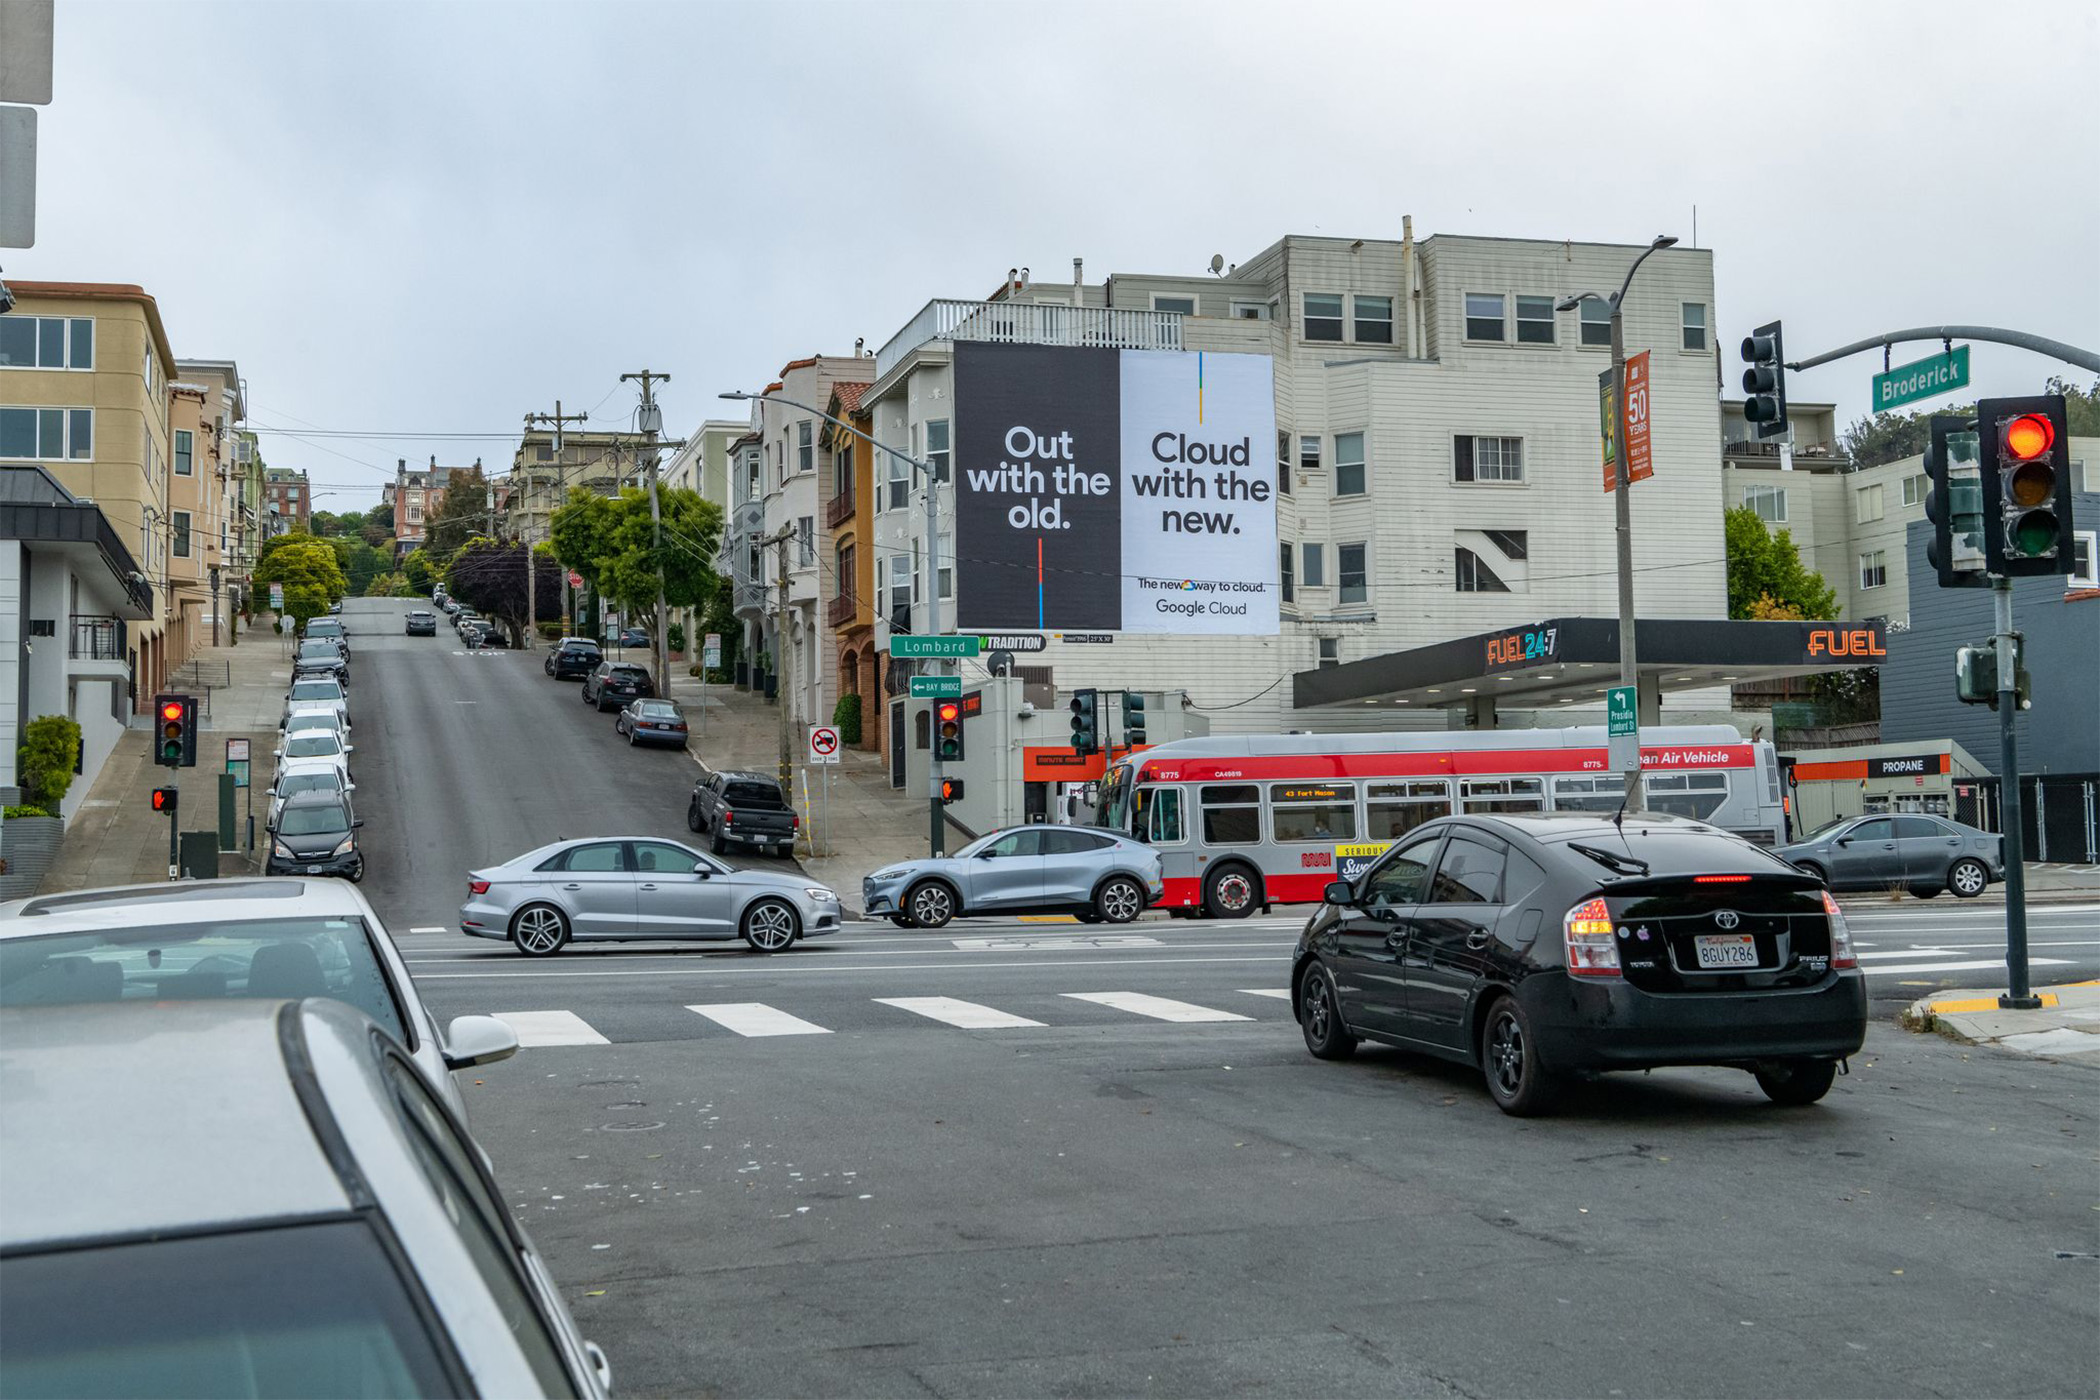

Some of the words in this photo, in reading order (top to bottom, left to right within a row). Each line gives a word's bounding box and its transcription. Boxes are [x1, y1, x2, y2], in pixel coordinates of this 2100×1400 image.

[1882, 361, 1958, 401] Broderick
[1628, 389, 1646, 424] 50
[1629, 421, 1647, 436] YEARS
[1004, 425, 1074, 460] Out
[1151, 432, 1250, 467] Cloud
[967, 461, 1045, 493] with
[1052, 464, 1111, 496] the
[1132, 467, 1206, 499] with
[1214, 470, 1270, 502] the
[1008, 497, 1071, 530] old.
[1162, 510, 1240, 535] new.
[1138, 578, 1158, 589] The
[1160, 581, 1183, 590] new
[1193, 582, 1217, 593] way
[1219, 582, 1231, 592] to
[1232, 582, 1266, 593] cloud.
[1156, 598, 1205, 617] Google
[1208, 601, 1247, 615] Cloud
[904, 640, 965, 653] Lombard
[980, 636, 1042, 650] WTRADITION
[1807, 629, 1887, 657] FUEL
[926, 683, 938, 691] BAY
[940, 683, 960, 691] BRIDGE
[1611, 710, 1634, 720] Presidio
[1639, 754, 1658, 764] ean
[1660, 752, 1681, 764] Air
[1683, 750, 1729, 764] Vehicle
[1160, 771, 1179, 779] 8775
[1882, 760, 1924, 773] PROPANE
[1345, 847, 1384, 856] SERIOUS
[1701, 946, 1754, 963] 8GUY286
